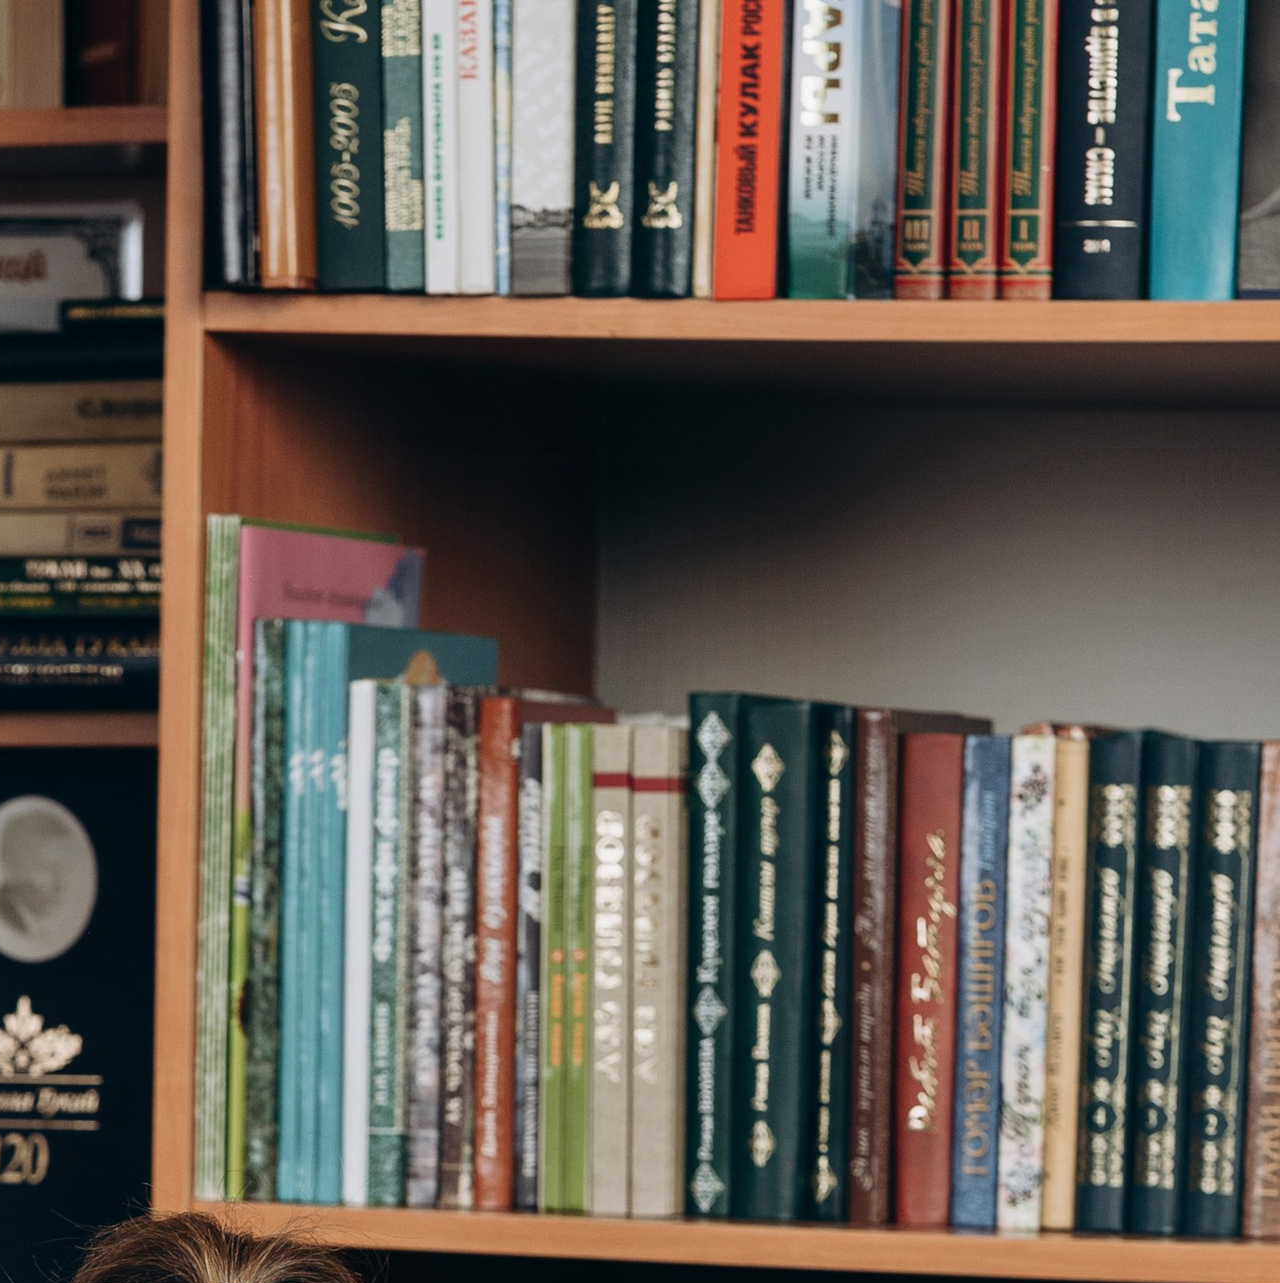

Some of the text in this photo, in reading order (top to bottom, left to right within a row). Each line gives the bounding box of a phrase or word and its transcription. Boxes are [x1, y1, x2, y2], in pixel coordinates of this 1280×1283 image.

[738, 42, 761, 138] КУЛАК
[734, 142, 757, 235] ТАНКОВЫЙ
[961, 879, 998, 1176] ГОМӘР БӘШИРОВ
